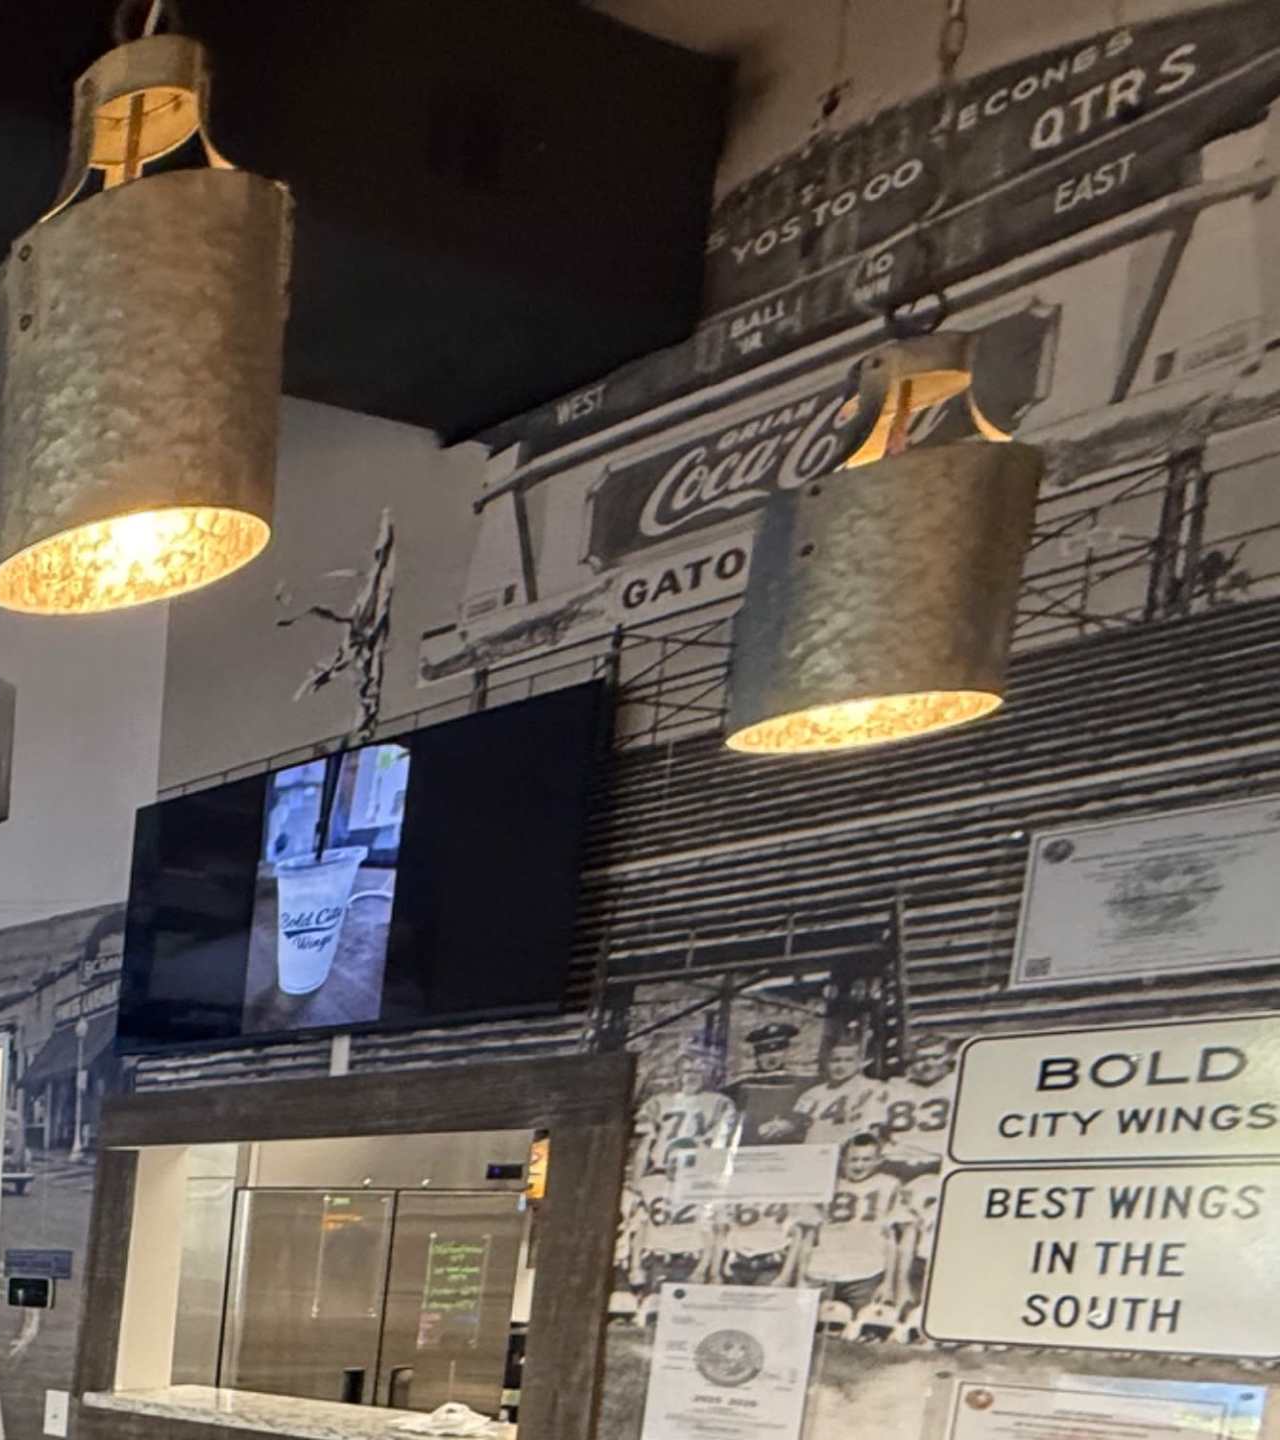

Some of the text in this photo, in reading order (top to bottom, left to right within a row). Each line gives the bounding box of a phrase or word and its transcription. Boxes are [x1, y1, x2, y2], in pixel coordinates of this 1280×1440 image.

[1030, 43, 1197, 151] QTRS
[1054, 152, 1137, 214] EAST
[1036, 1046, 1249, 1092] BOLD
[887, 1098, 951, 1132] 83
[997, 1102, 1279, 1139] CITY WINGS
[985, 1184, 1265, 1221] BEST WINGS
[1031, 1240, 1188, 1278] IN THE
[1021, 1293, 1182, 1334] SOUTH
